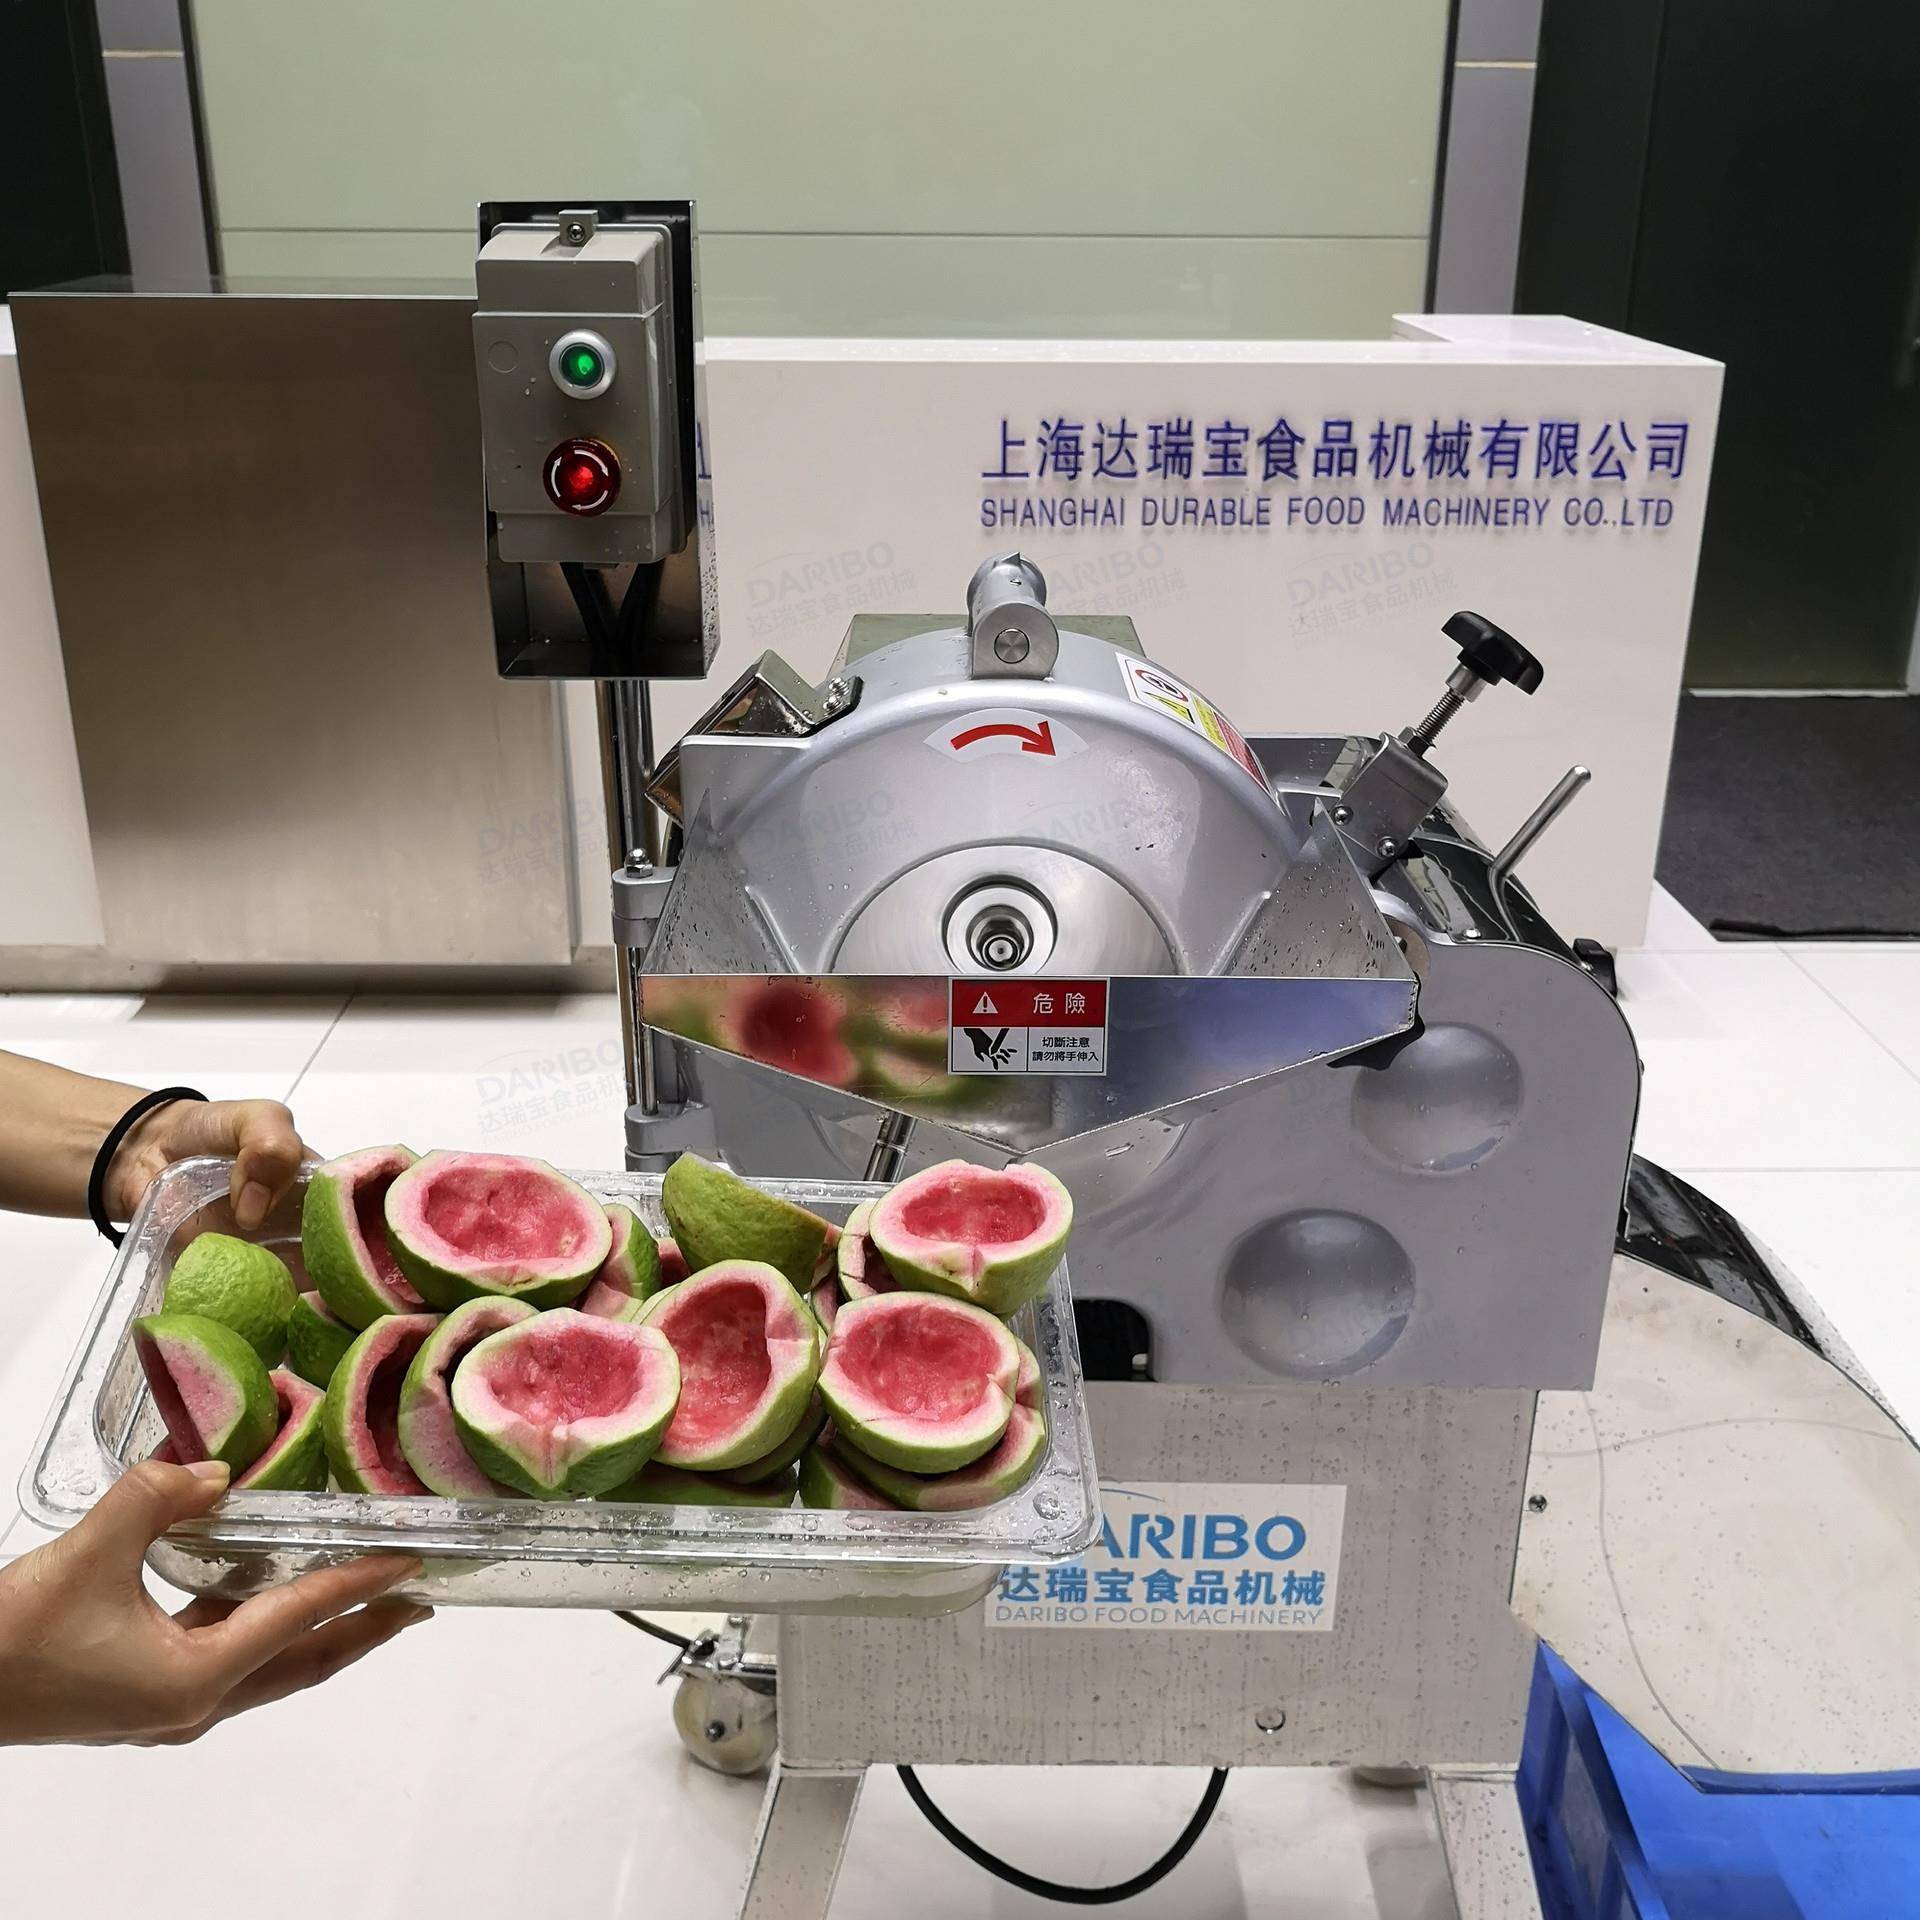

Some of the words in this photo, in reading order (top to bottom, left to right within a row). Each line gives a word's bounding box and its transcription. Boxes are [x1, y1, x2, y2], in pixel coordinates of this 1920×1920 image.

[981, 418, 1689, 482] 上海达瑞宝食品机械有限公司
[980, 496, 1126, 528] SHANGHAI
[1141, 496, 1272, 527] DURABLE
[1287, 497, 1365, 527] FOOD
[1382, 497, 1550, 527] MACHINERY
[1033, 992, 1086, 1015] 危險
[1041, 1036, 1090, 1048] 切斷注意
[1032, 1051, 1099, 1062] 請勿將手伸入
[1096, 1513, 1307, 1561] ARIBO
[997, 1566, 1326, 1606] 达瑞宝食品机械
[995, 1606, 1088, 1623] DARIBO
[1095, 1607, 1167, 1624] FOOD
[1174, 1608, 1323, 1626] MACHINERY
